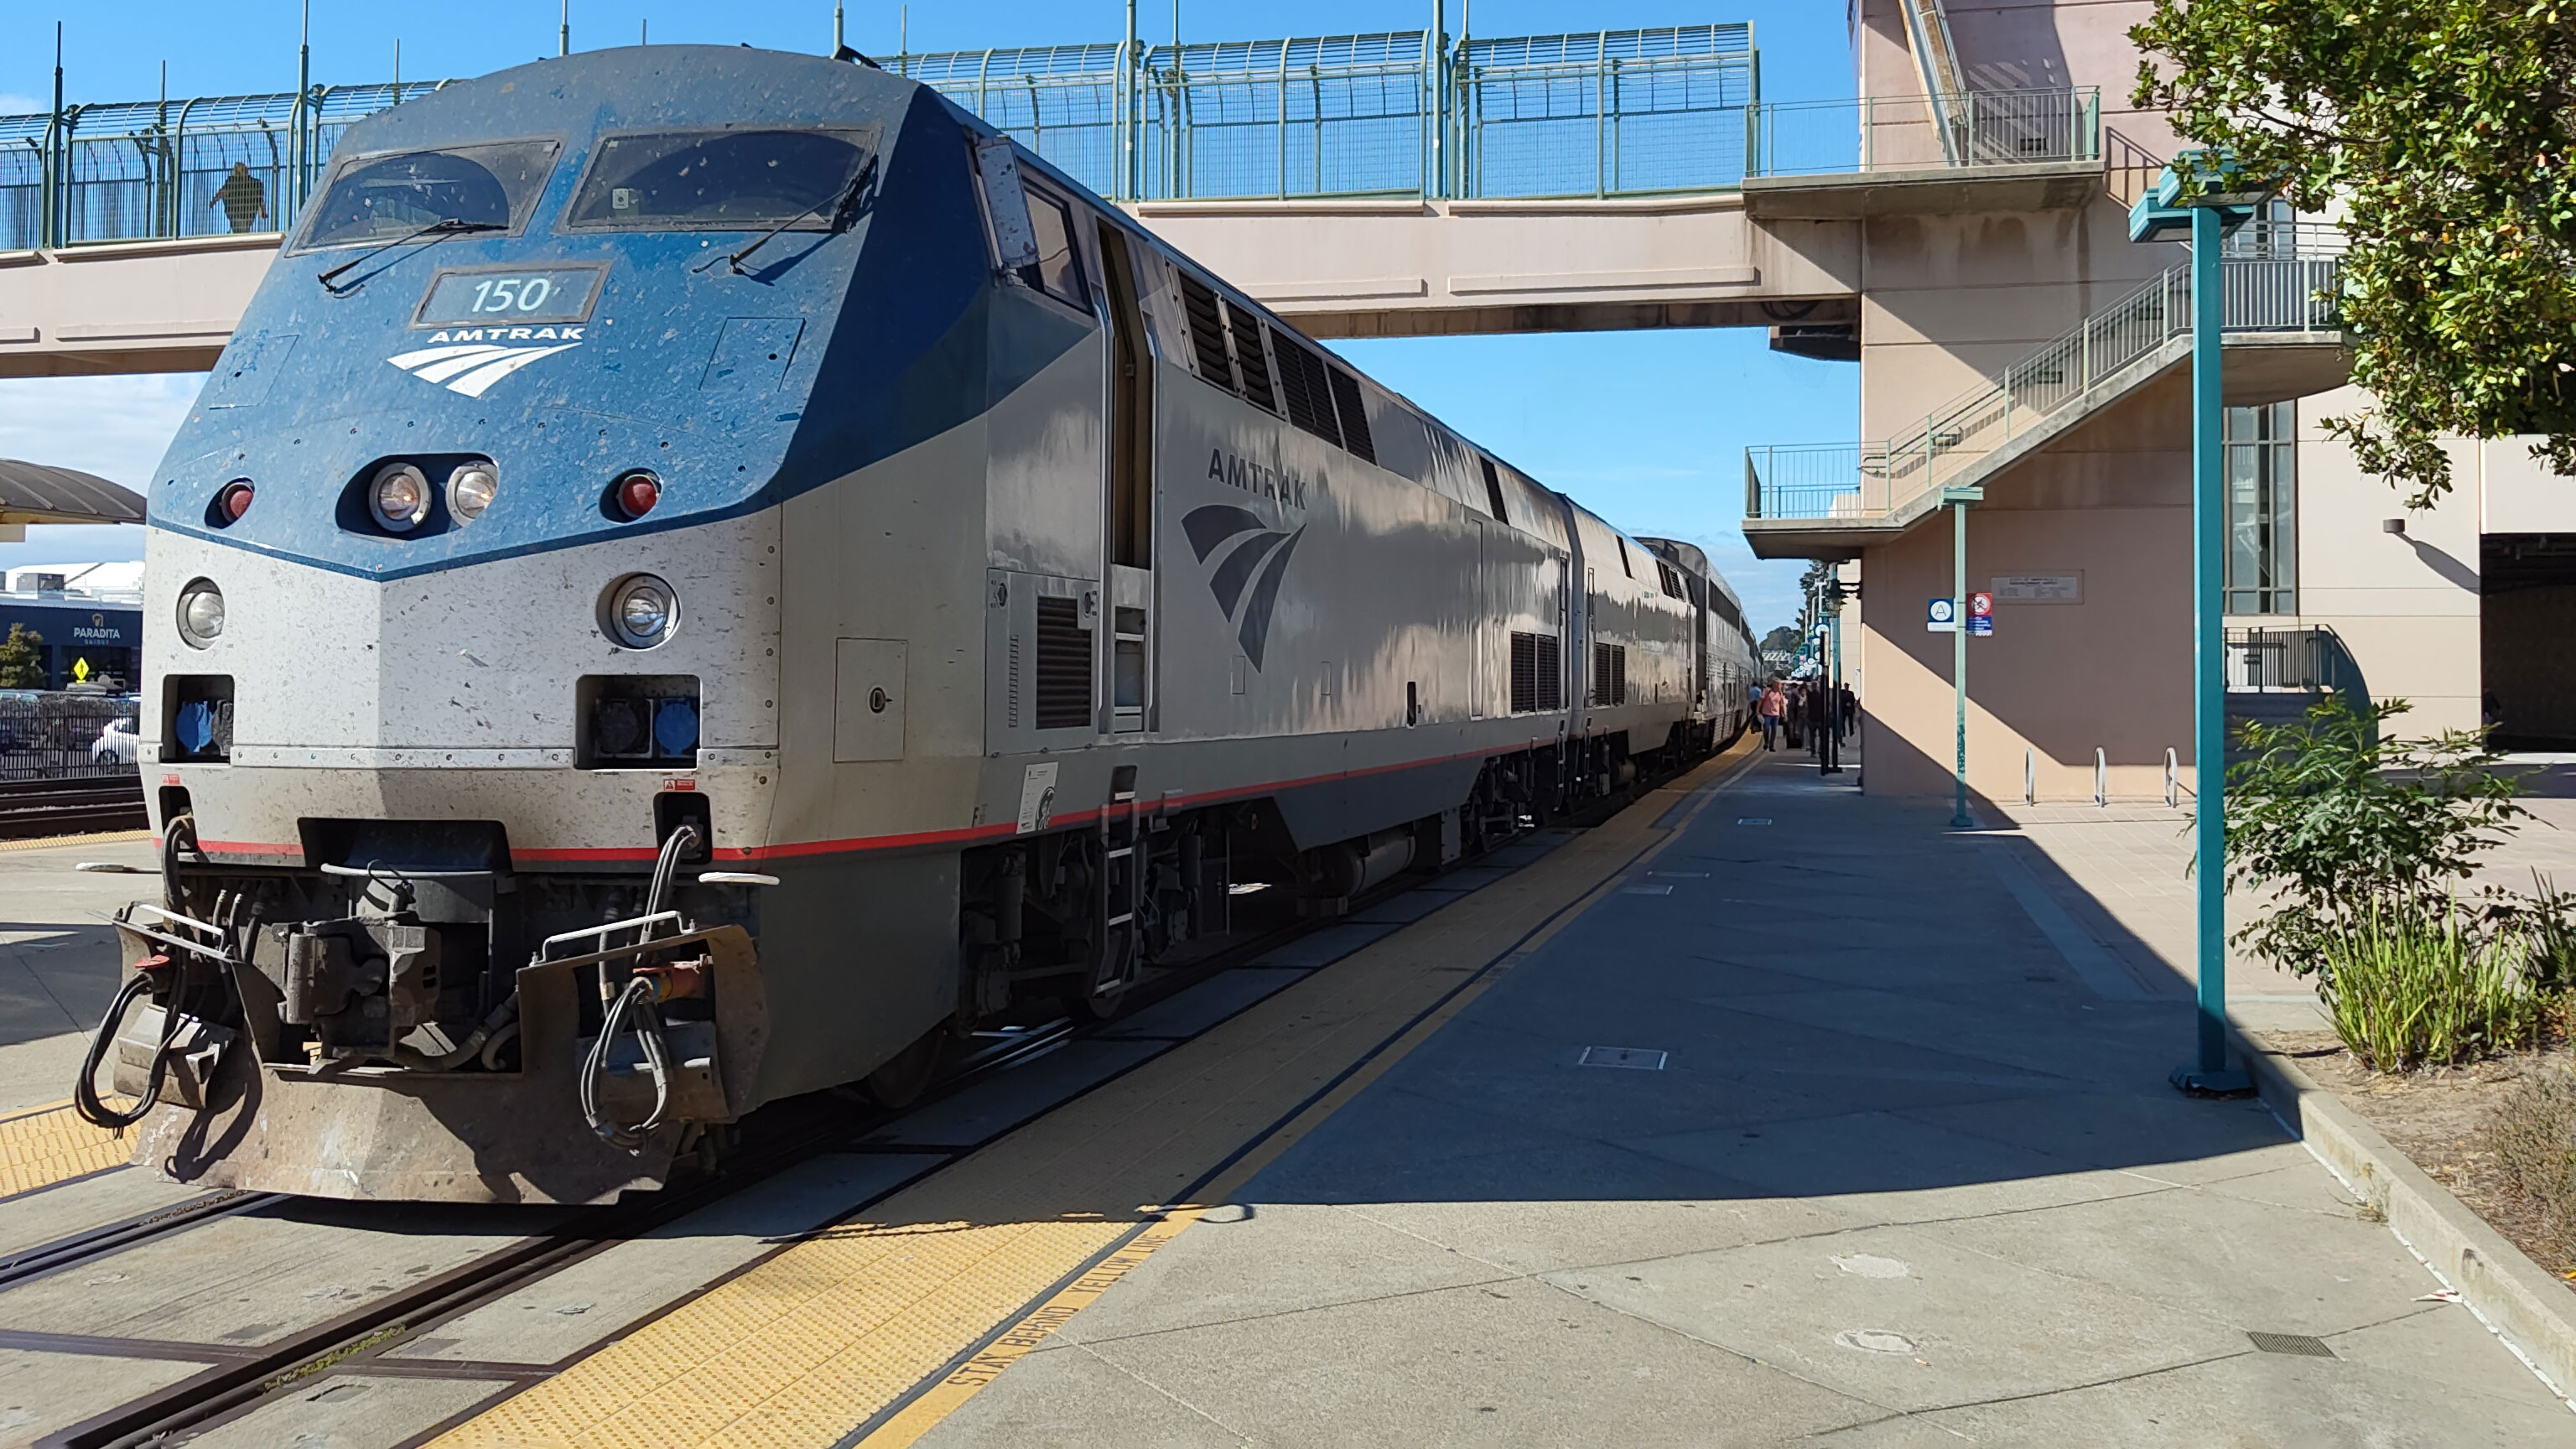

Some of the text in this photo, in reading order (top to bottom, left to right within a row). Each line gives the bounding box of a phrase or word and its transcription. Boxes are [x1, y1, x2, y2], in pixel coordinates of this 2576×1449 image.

[472, 278, 550, 313] 150
[427, 328, 586, 344] AMTRAK
[1208, 448, 1306, 511] AMTRAK
[1935, 604, 1947, 616] A
[74, 627, 120, 639] PARADITA
[946, 1234, 1174, 1386] STAY BEHIND YELLOW LINE
